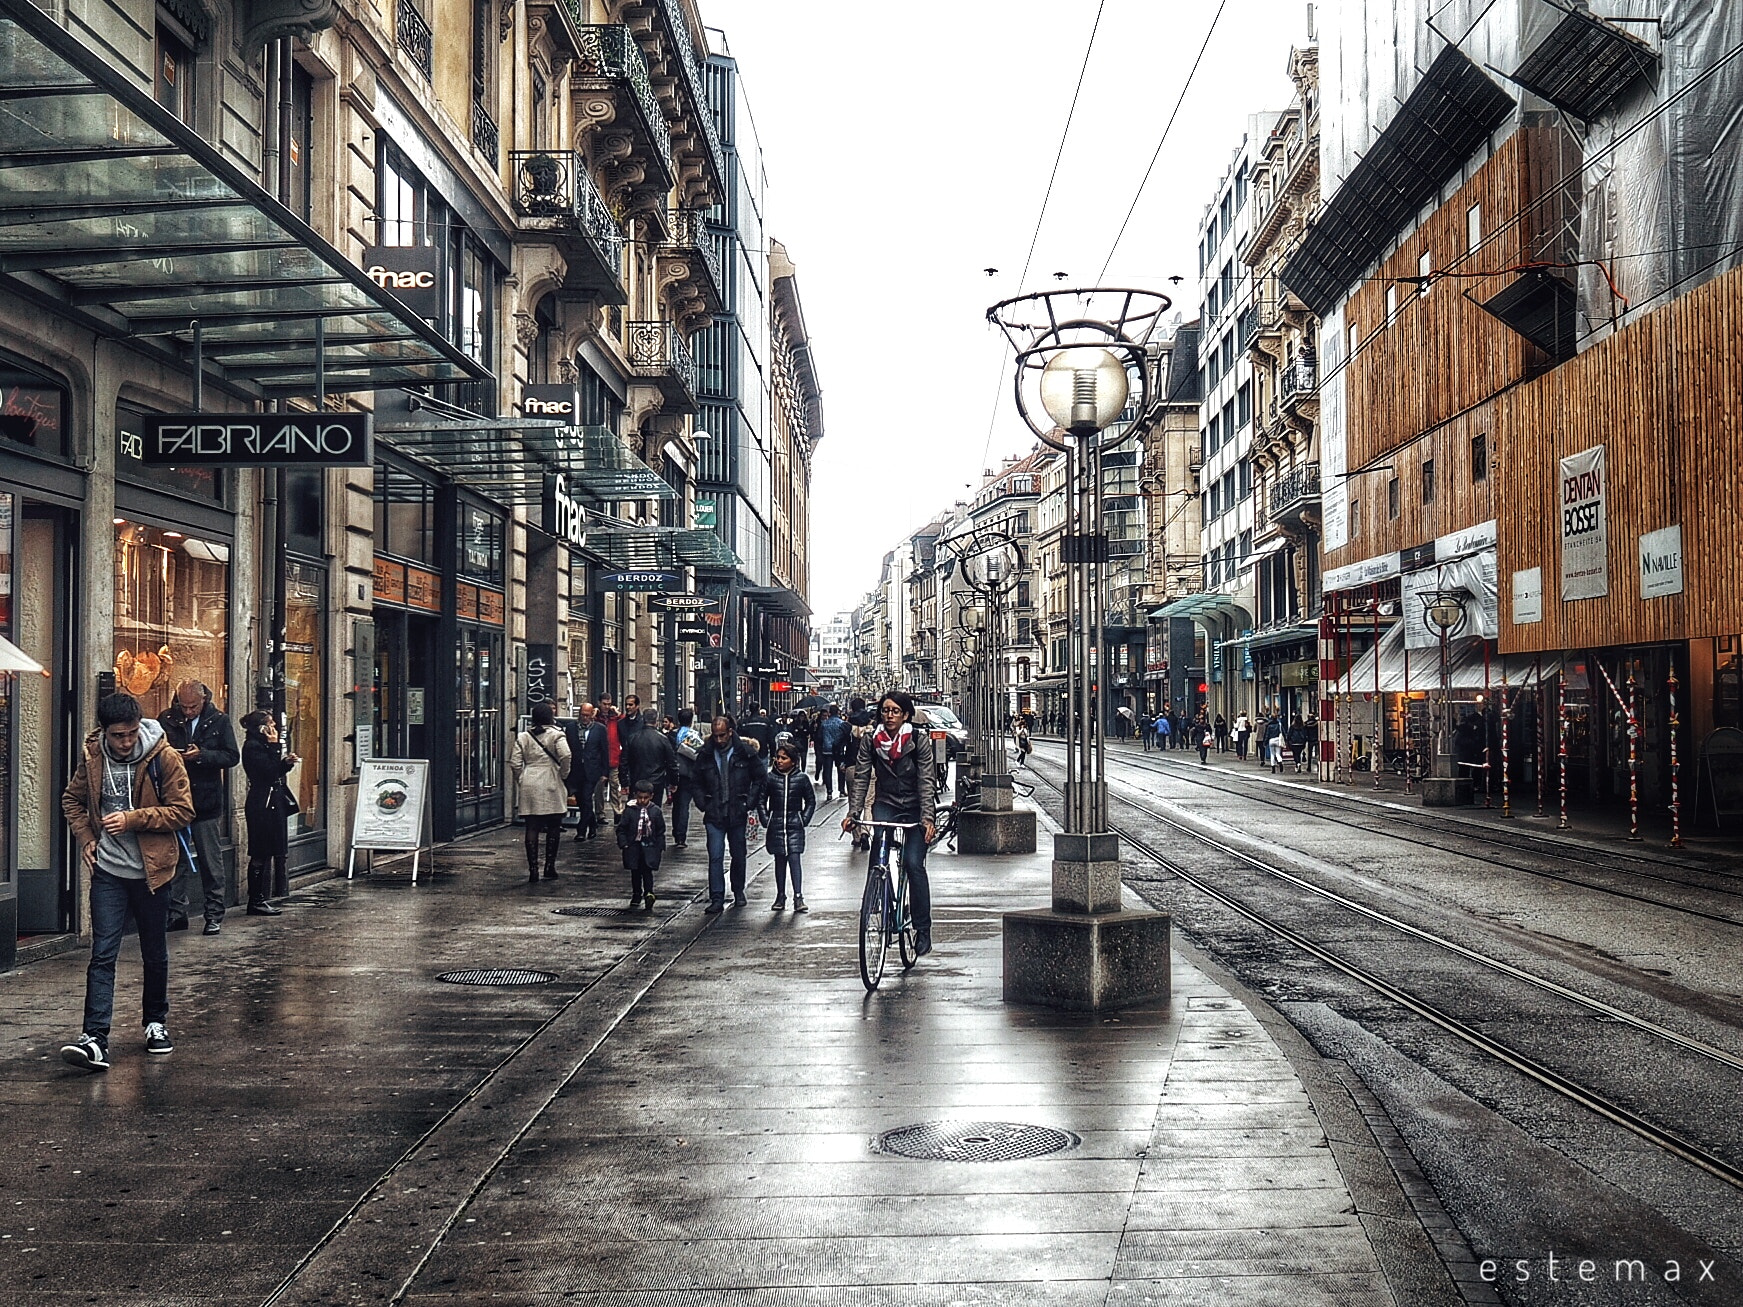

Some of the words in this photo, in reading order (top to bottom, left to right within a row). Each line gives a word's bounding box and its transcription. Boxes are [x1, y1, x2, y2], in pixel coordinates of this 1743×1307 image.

[367, 265, 434, 288] fnac
[3, 386, 57, 438] boutique
[524, 397, 573, 414] fnac
[158, 424, 353, 454] FABRIANO
[1563, 468, 1601, 505] DENTAN
[555, 473, 587, 548] fnac
[1564, 500, 1601, 537] BOSSET
[617, 574, 663, 582] BERDOZ
[1652, 552, 1678, 574] NAVILLE
